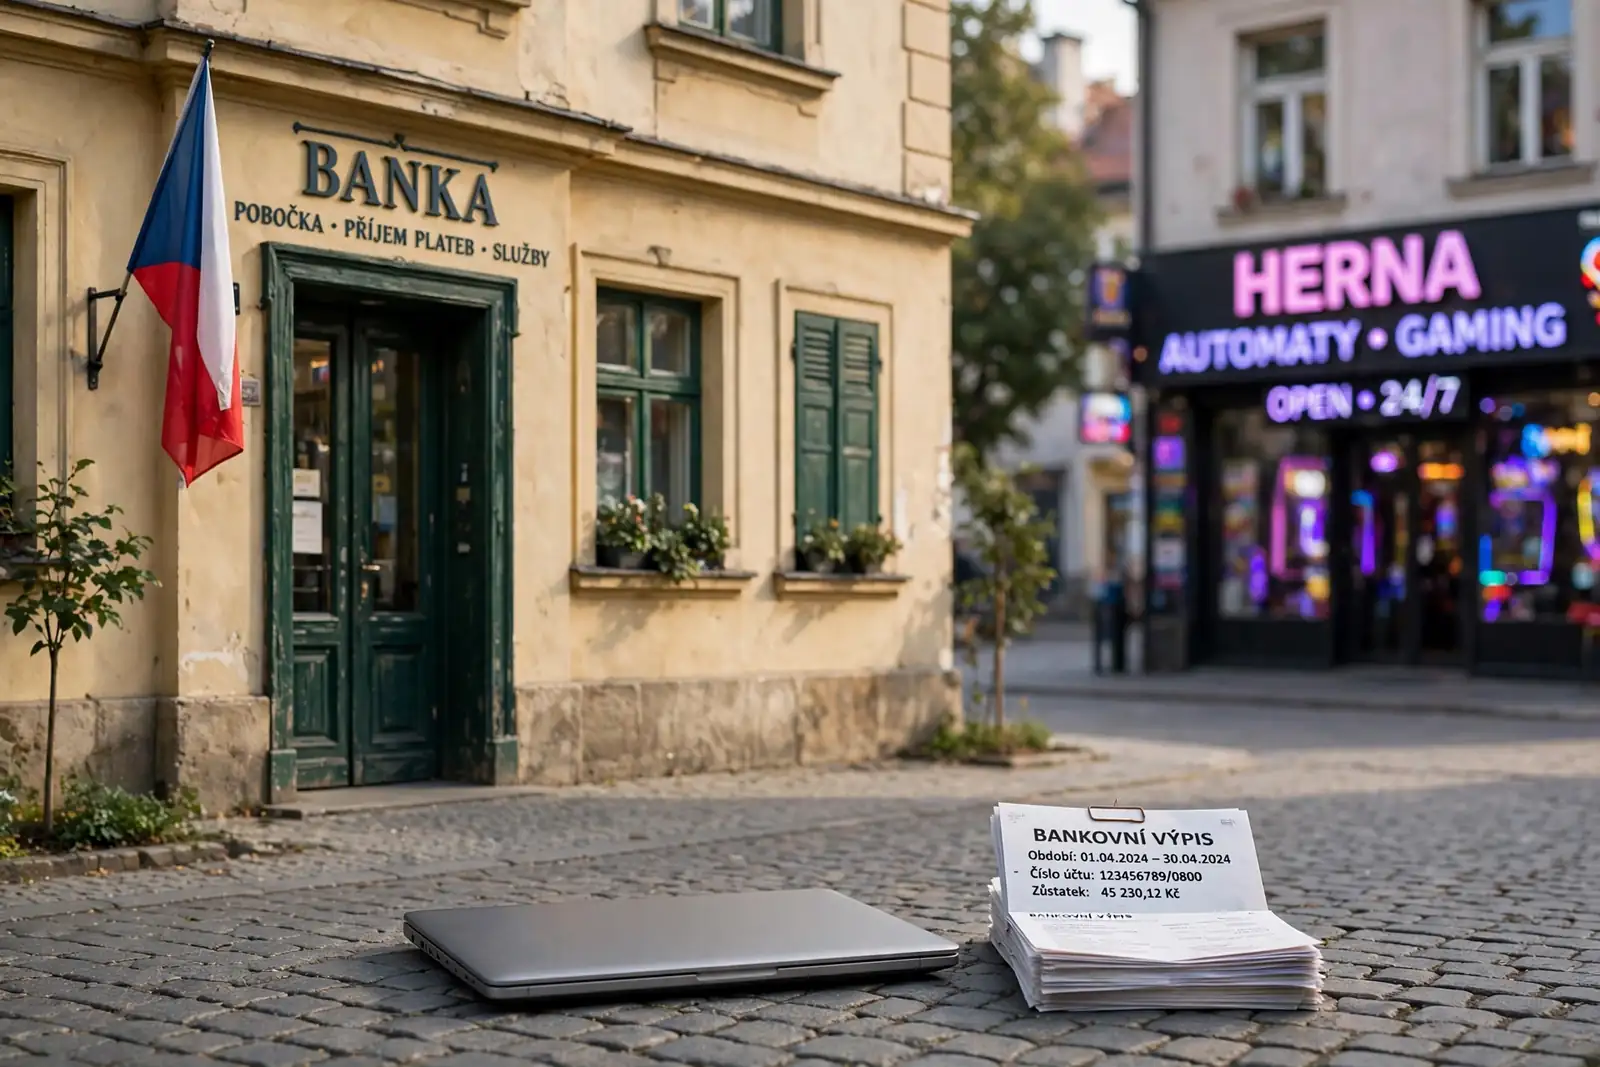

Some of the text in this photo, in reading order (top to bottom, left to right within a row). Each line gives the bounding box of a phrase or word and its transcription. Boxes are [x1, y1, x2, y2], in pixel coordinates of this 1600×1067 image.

[301, 139, 499, 227] BANKA
[234, 200, 550, 268] POBOČKA PŘÍJEM PLATEB SLUŽBY
[1233, 230, 1481, 318] HERNA
[1158, 302, 1567, 374] AUTOMATY GAMING
[1266, 373, 1461, 423] OPEN 24/7
[1027, 849, 1077, 862] Období:
[1080, 851, 1149, 863] 01.04.2024
[1162, 853, 1231, 864] 30.04.2024
[1033, 828, 1214, 846] BANKOVNÍ VÝPIS
[1030, 865, 1203, 883] Číslo účtu: 123456789/0800
[1031, 883, 1181, 901] Zůstatek: 45 230,12 Kč
